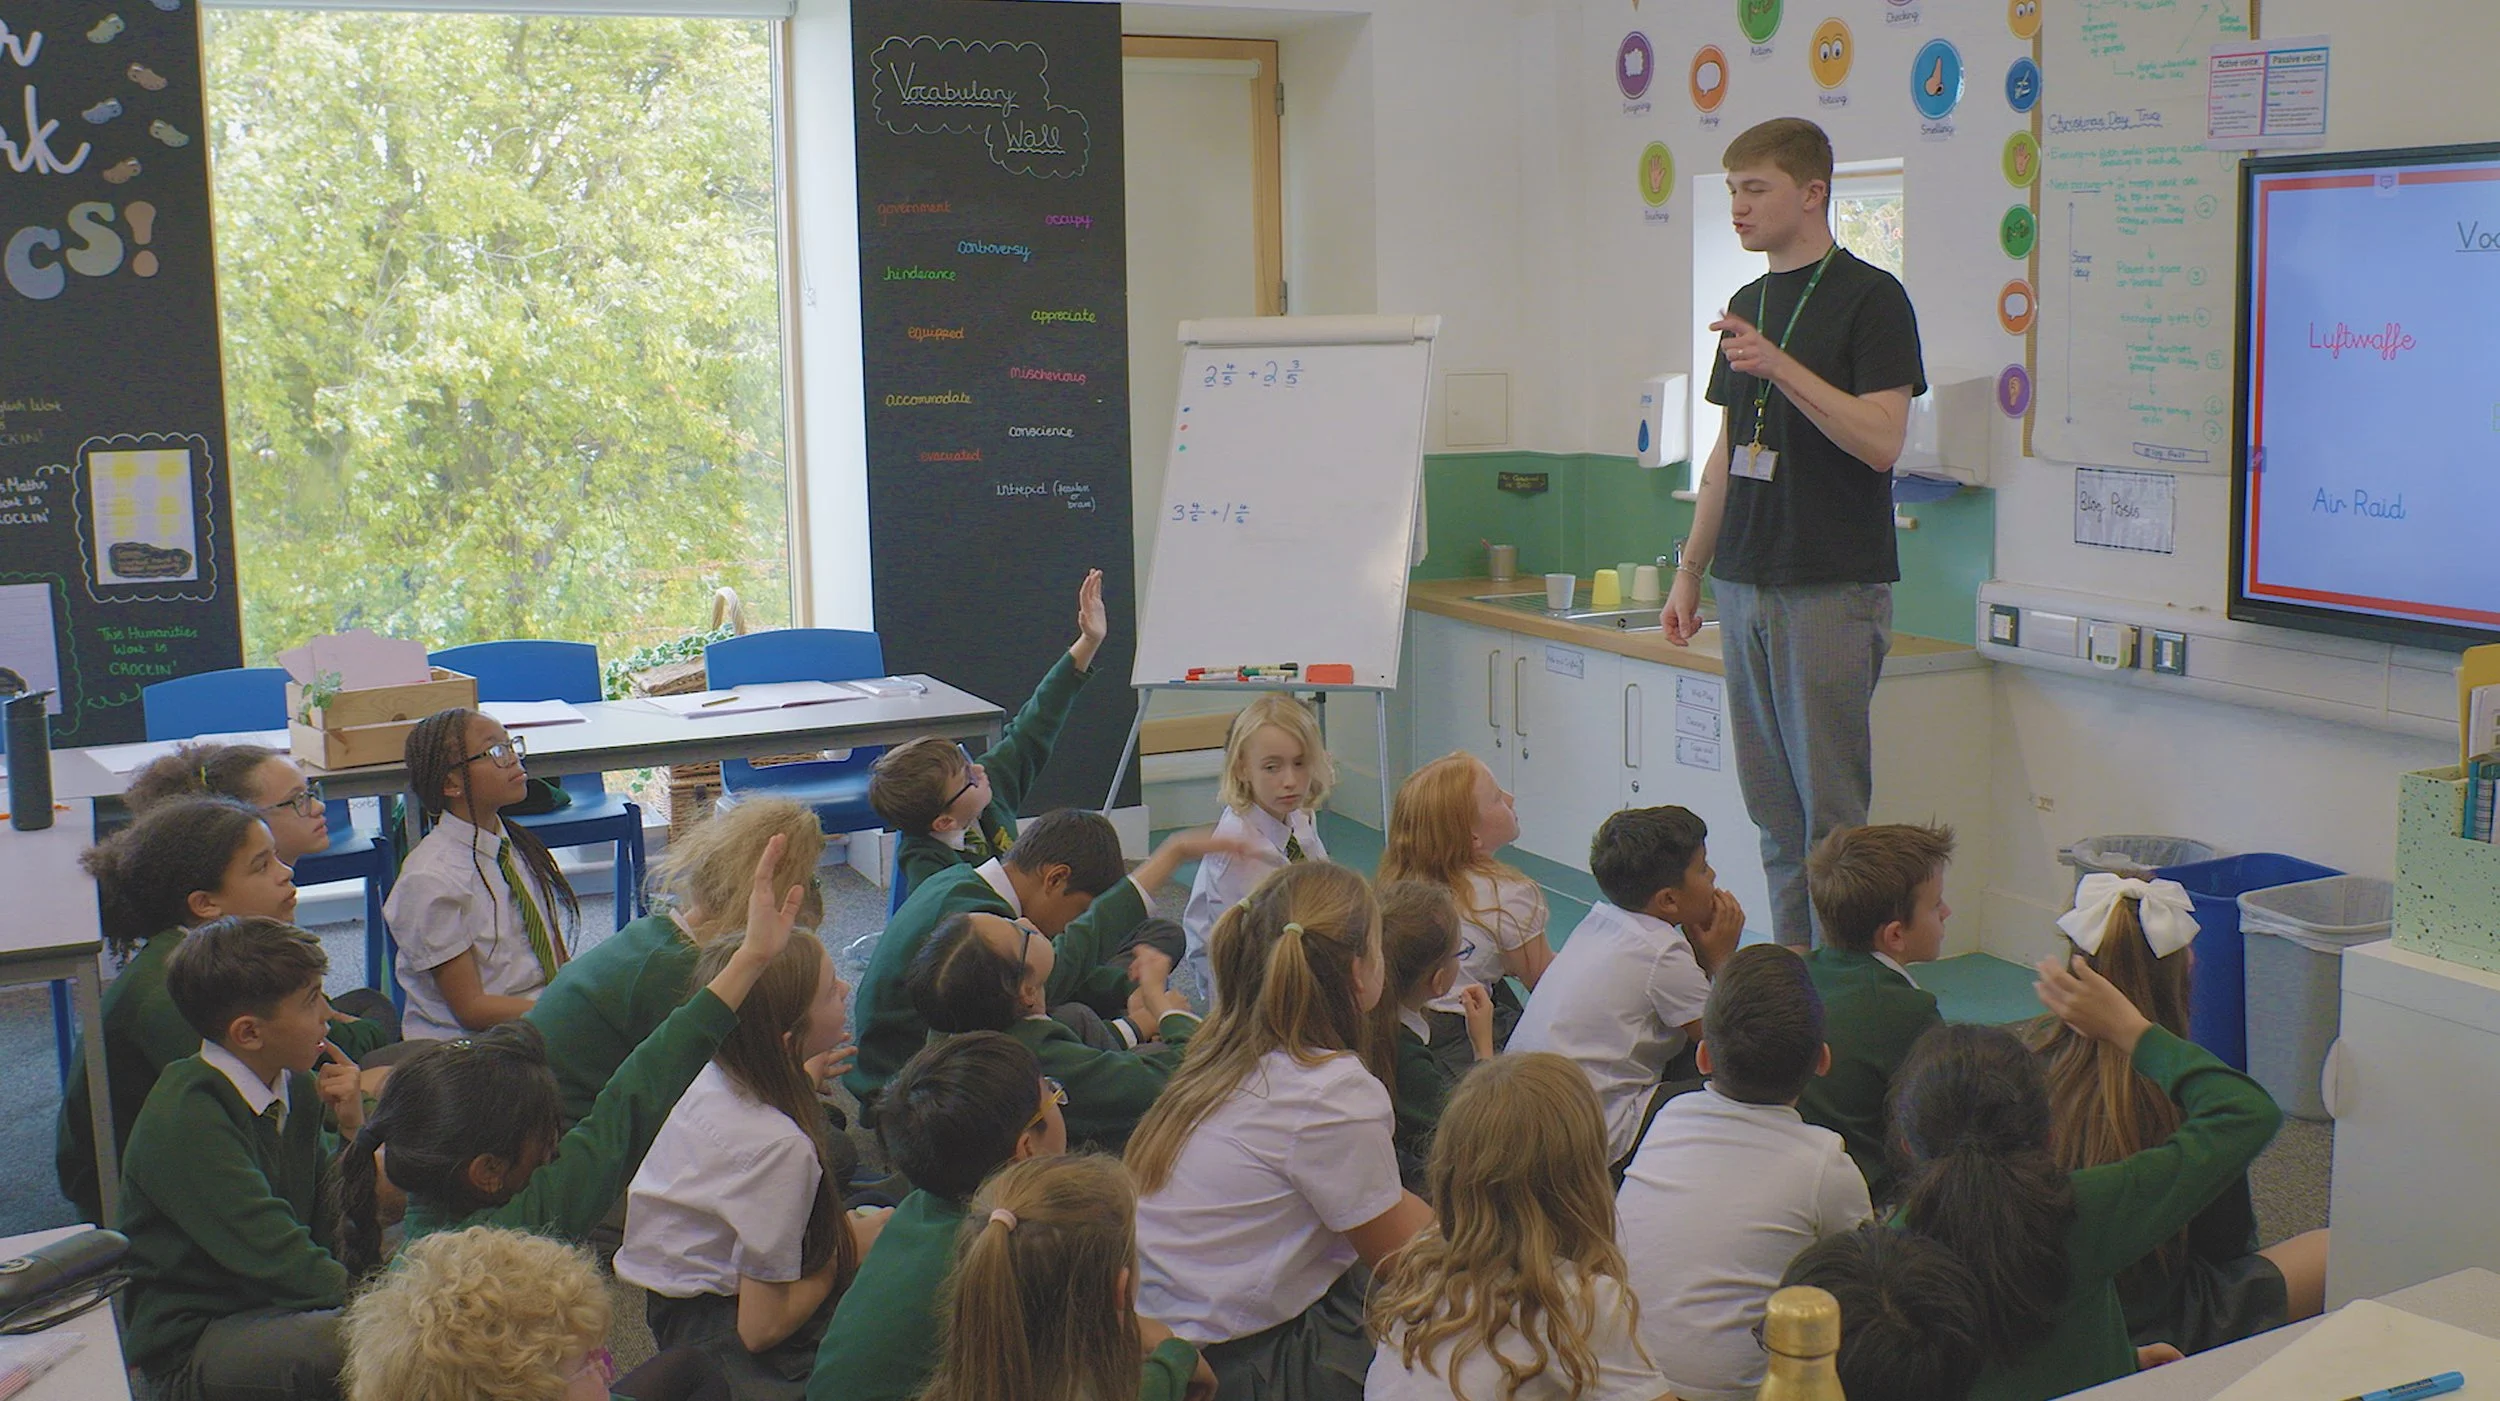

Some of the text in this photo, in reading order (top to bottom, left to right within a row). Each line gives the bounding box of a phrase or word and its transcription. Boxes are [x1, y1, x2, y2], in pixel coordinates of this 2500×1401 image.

[2217, 58, 2258, 69] Active voice
[2271, 53, 2322, 65] Passive voice
[890, 62, 1017, 118] Vocabulary
[2048, 112, 2105, 130] Christmas
[2107, 110, 2129, 128] Day
[1002, 119, 1063, 149] Wall
[1920, 123, 1954, 136] Smelling
[878, 200, 952, 227] government
[1045, 212, 1094, 229] occupy
[957, 239, 1032, 262] controversy
[884, 264, 957, 282] hinderance
[1031, 308, 1097, 326] appreciate
[908, 326, 965, 344] equipped
[2309, 321, 2417, 360] Luftwaffe
[1204, 364, 1218, 385] 2
[1263, 361, 1278, 384] 2
[885, 390, 972, 407] accommodate
[1008, 425, 1075, 439] conscience
[920, 448, 982, 462] evacuated
[996, 481, 1048, 499] intrepid
[2312, 487, 2407, 520] Air Raid
[96, 624, 198, 641] This Humanities
